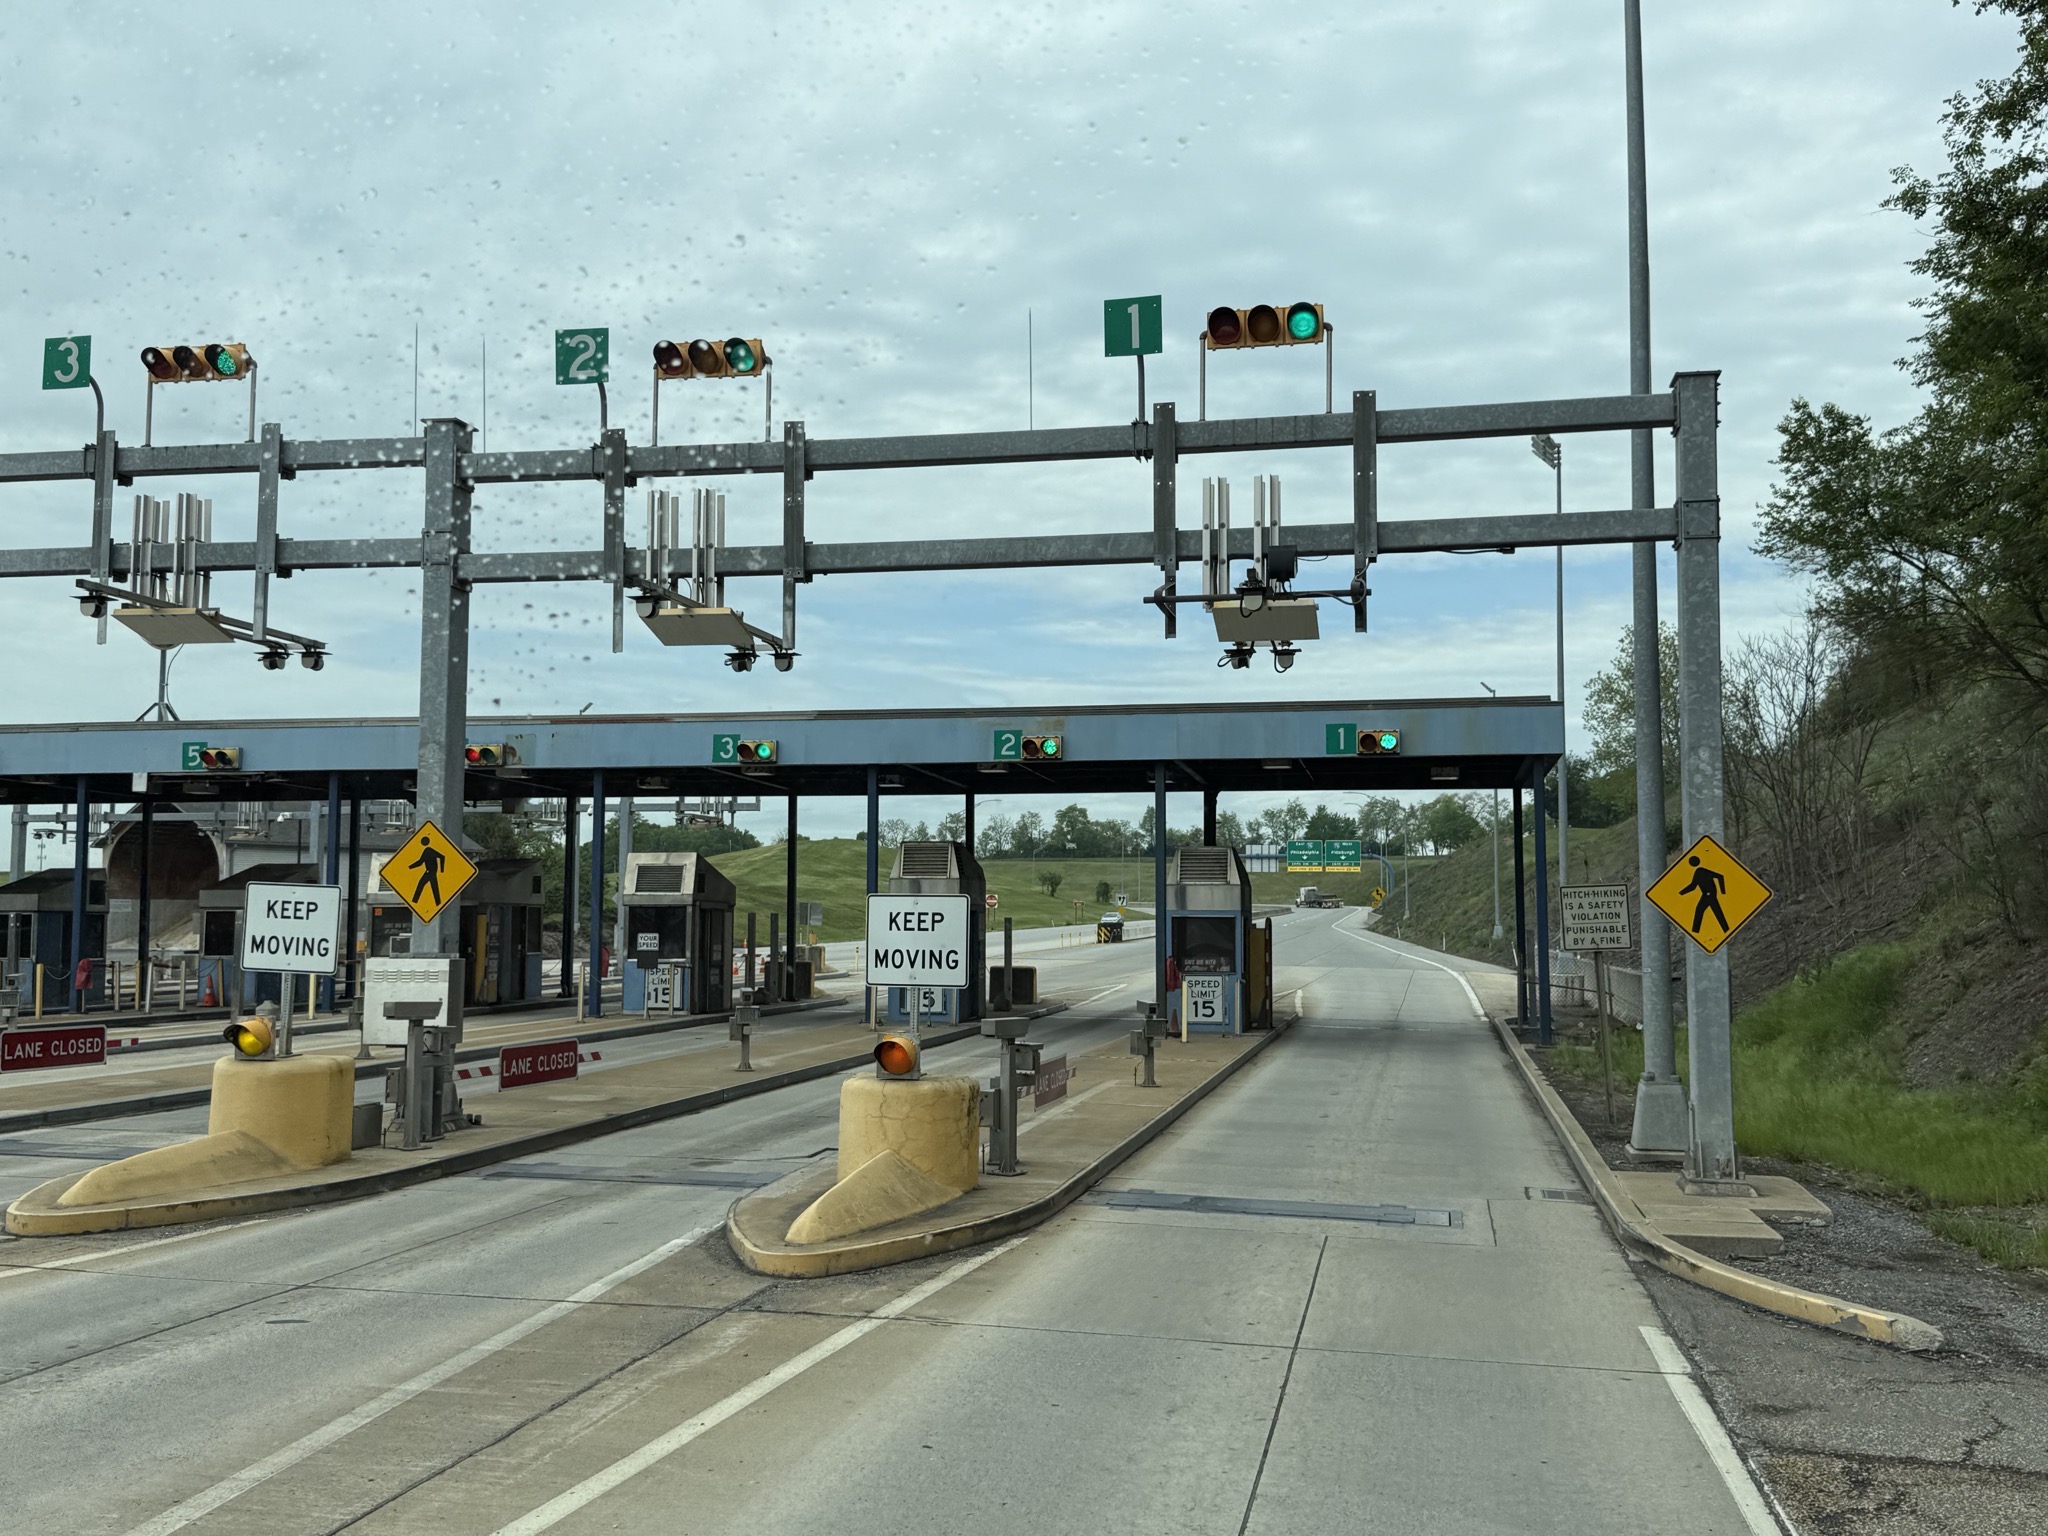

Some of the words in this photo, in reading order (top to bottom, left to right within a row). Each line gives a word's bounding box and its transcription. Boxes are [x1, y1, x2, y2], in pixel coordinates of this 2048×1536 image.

[1127, 303, 1140, 349] 1
[54, 340, 79, 383] 3
[568, 334, 598, 379] 2
[720, 737, 734, 759] 3
[1001, 733, 1016, 755] 2
[1337, 727, 1345, 750] 1
[188, 745, 201, 767] 5
[1562, 889, 1626, 899] HITCH-HIKING
[1587, 900, 1625, 910] SAFETY
[266, 899, 319, 921] KEEP
[1570, 911, 1621, 921] VIOLATION
[888, 911, 945, 932] KEEP
[1566, 925, 1627, 935] PUNISHABLE
[250, 934, 330, 958] MOVING
[1573, 937, 1586, 946] BY
[1590, 937, 1597, 945] A
[1600, 936, 1622, 945] FINE
[874, 948, 959, 970] MOVING
[651, 977, 670, 986] LIMI
[1187, 980, 1220, 988] SPEED
[1191, 990, 1216, 998] LIMIT
[1192, 1000, 1215, 1018] 15
[4, 1041, 43, 1060] LANE
[51, 1037, 102, 1056] CLOSED
[503, 1057, 532, 1077] LANE
[537, 1051, 576, 1072] CLOSED
